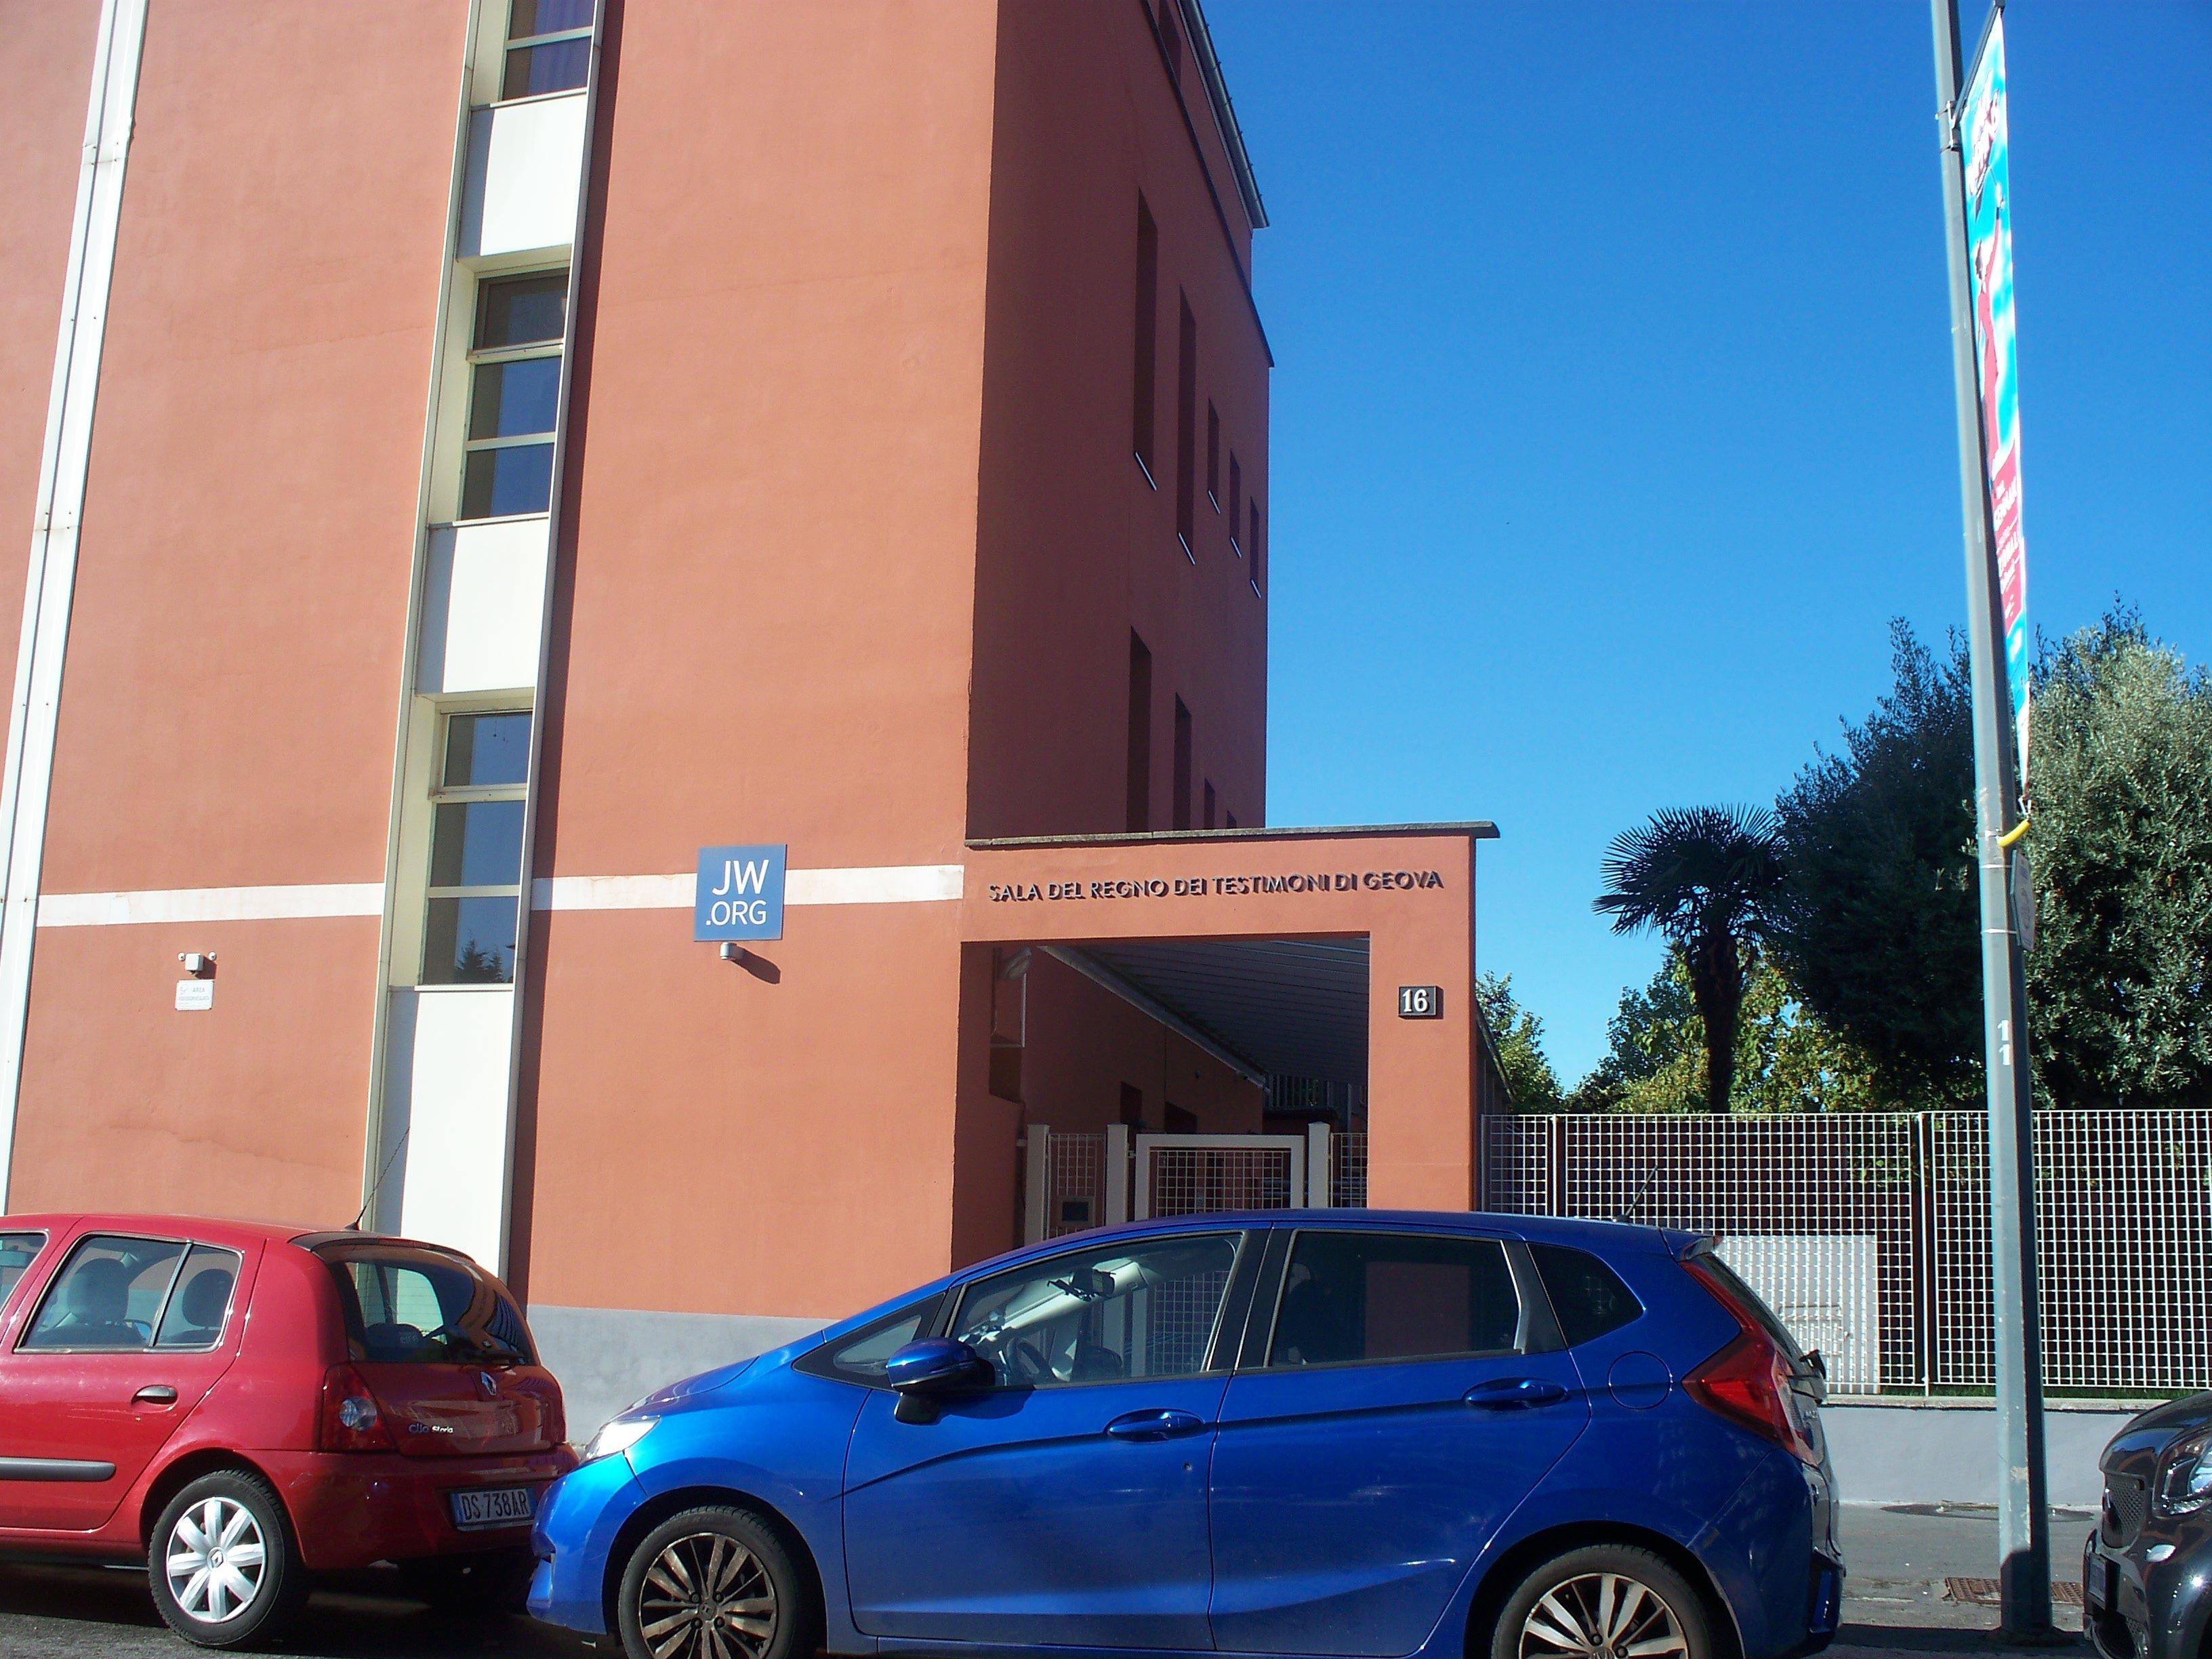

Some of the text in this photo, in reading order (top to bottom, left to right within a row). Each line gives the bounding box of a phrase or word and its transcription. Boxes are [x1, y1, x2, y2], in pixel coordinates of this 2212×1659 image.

[712, 859, 769, 896] JW
[989, 870, 1444, 902] SALA DEL REGNO DEI TESTIMONI DI GEOVA
[705, 899, 767, 926] .ORG
[1402, 989, 1427, 1012] 16
[462, 1490, 530, 1520] DS 738AR
